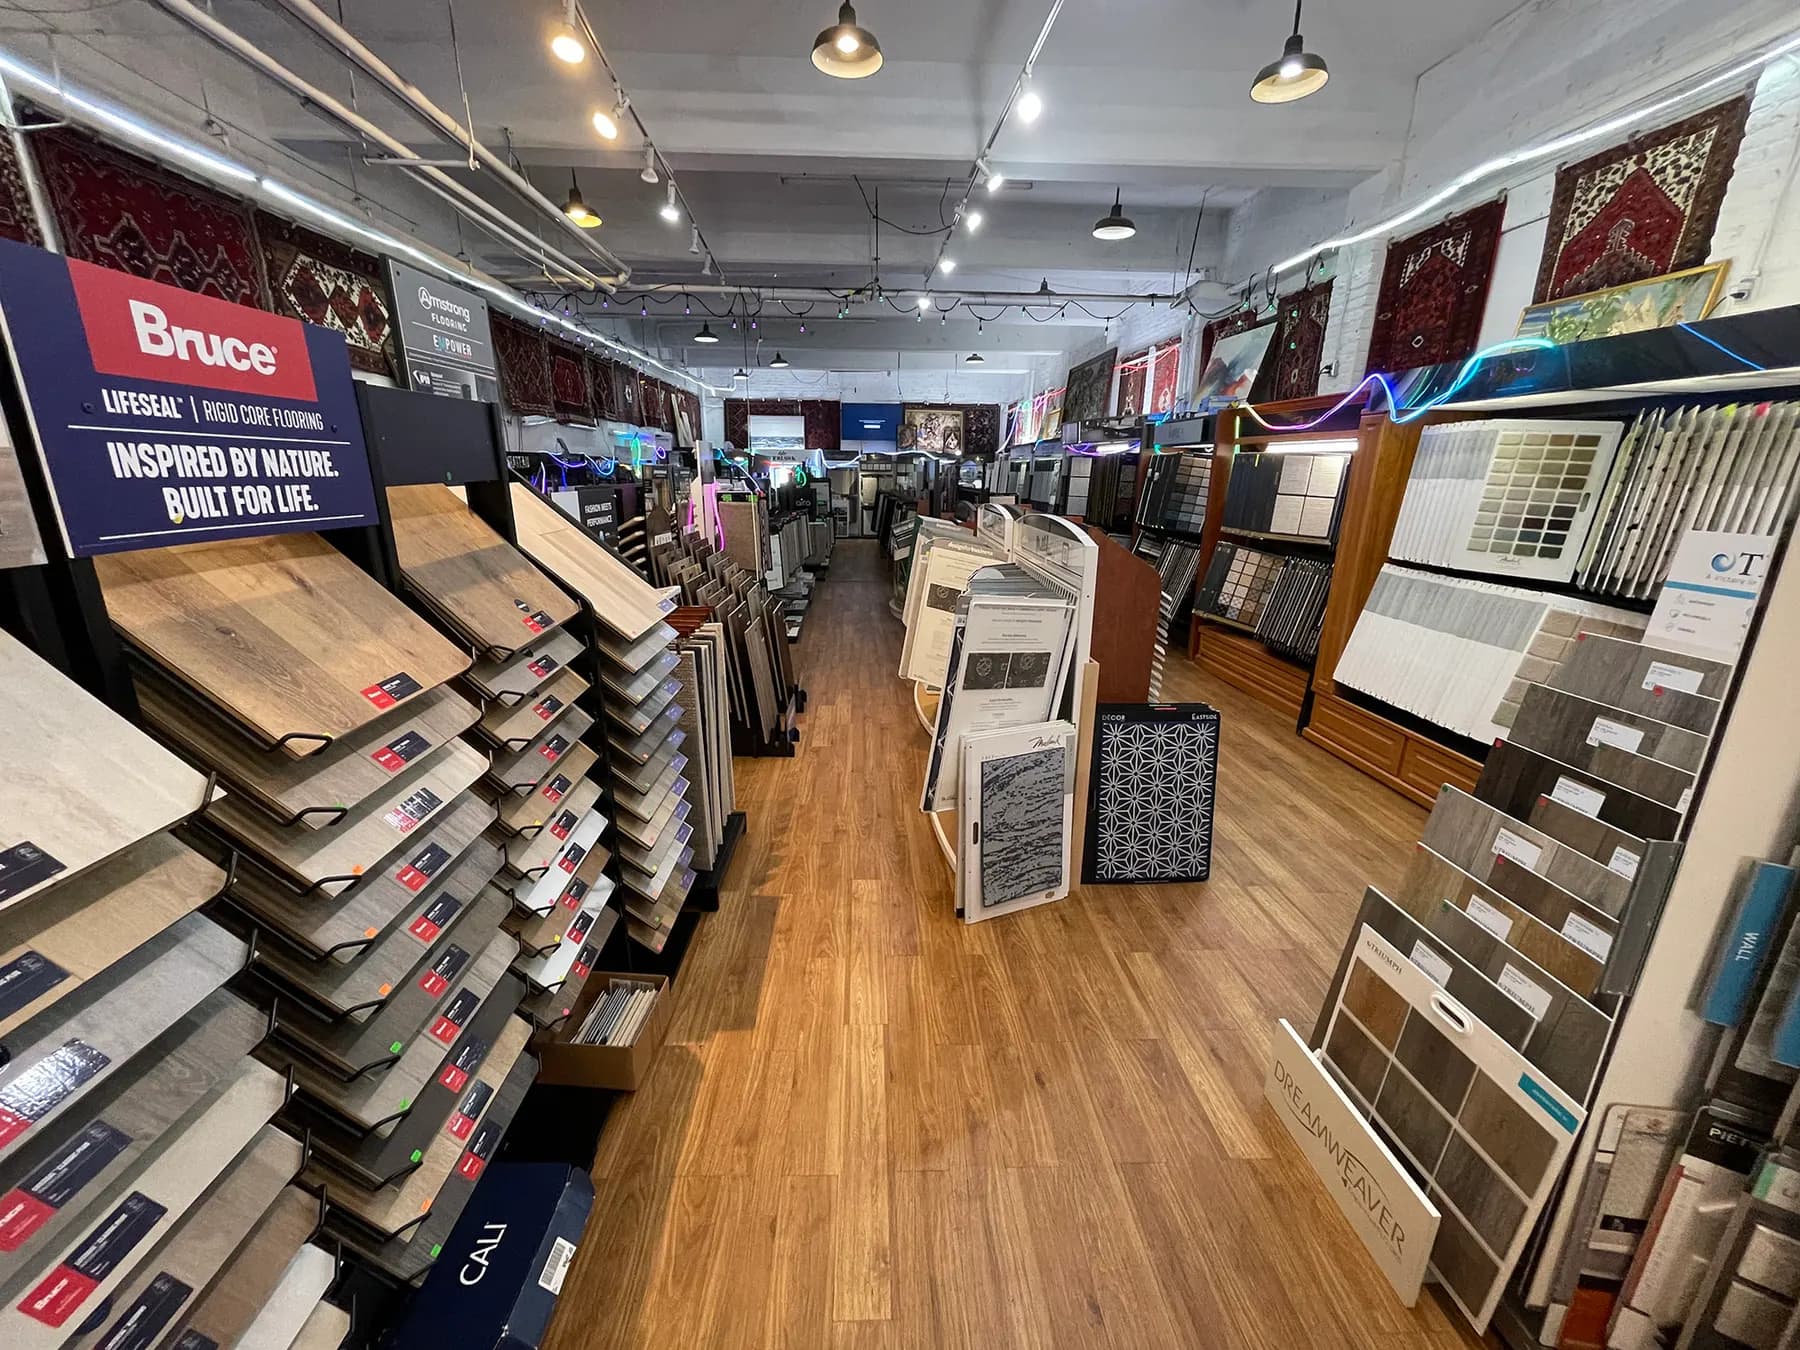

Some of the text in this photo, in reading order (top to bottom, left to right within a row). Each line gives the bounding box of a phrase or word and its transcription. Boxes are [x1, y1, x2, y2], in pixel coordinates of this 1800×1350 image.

[418, 286, 471, 323] Armstrong
[431, 312, 468, 332] FLOORING
[128, 299, 278, 375] Bruce
[202, 399, 239, 423] RIGID
[240, 404, 272, 427] CORE
[273, 407, 324, 431] FLOORING
[106, 441, 340, 479] INSPIRED BY NATURE.
[162, 483, 320, 523] BUILT FOR LIFE.
[1735, 932, 1760, 961] WALL
[1274, 1059, 1405, 1255] DREAMWEAVER
[459, 1223, 508, 1286] CALI
